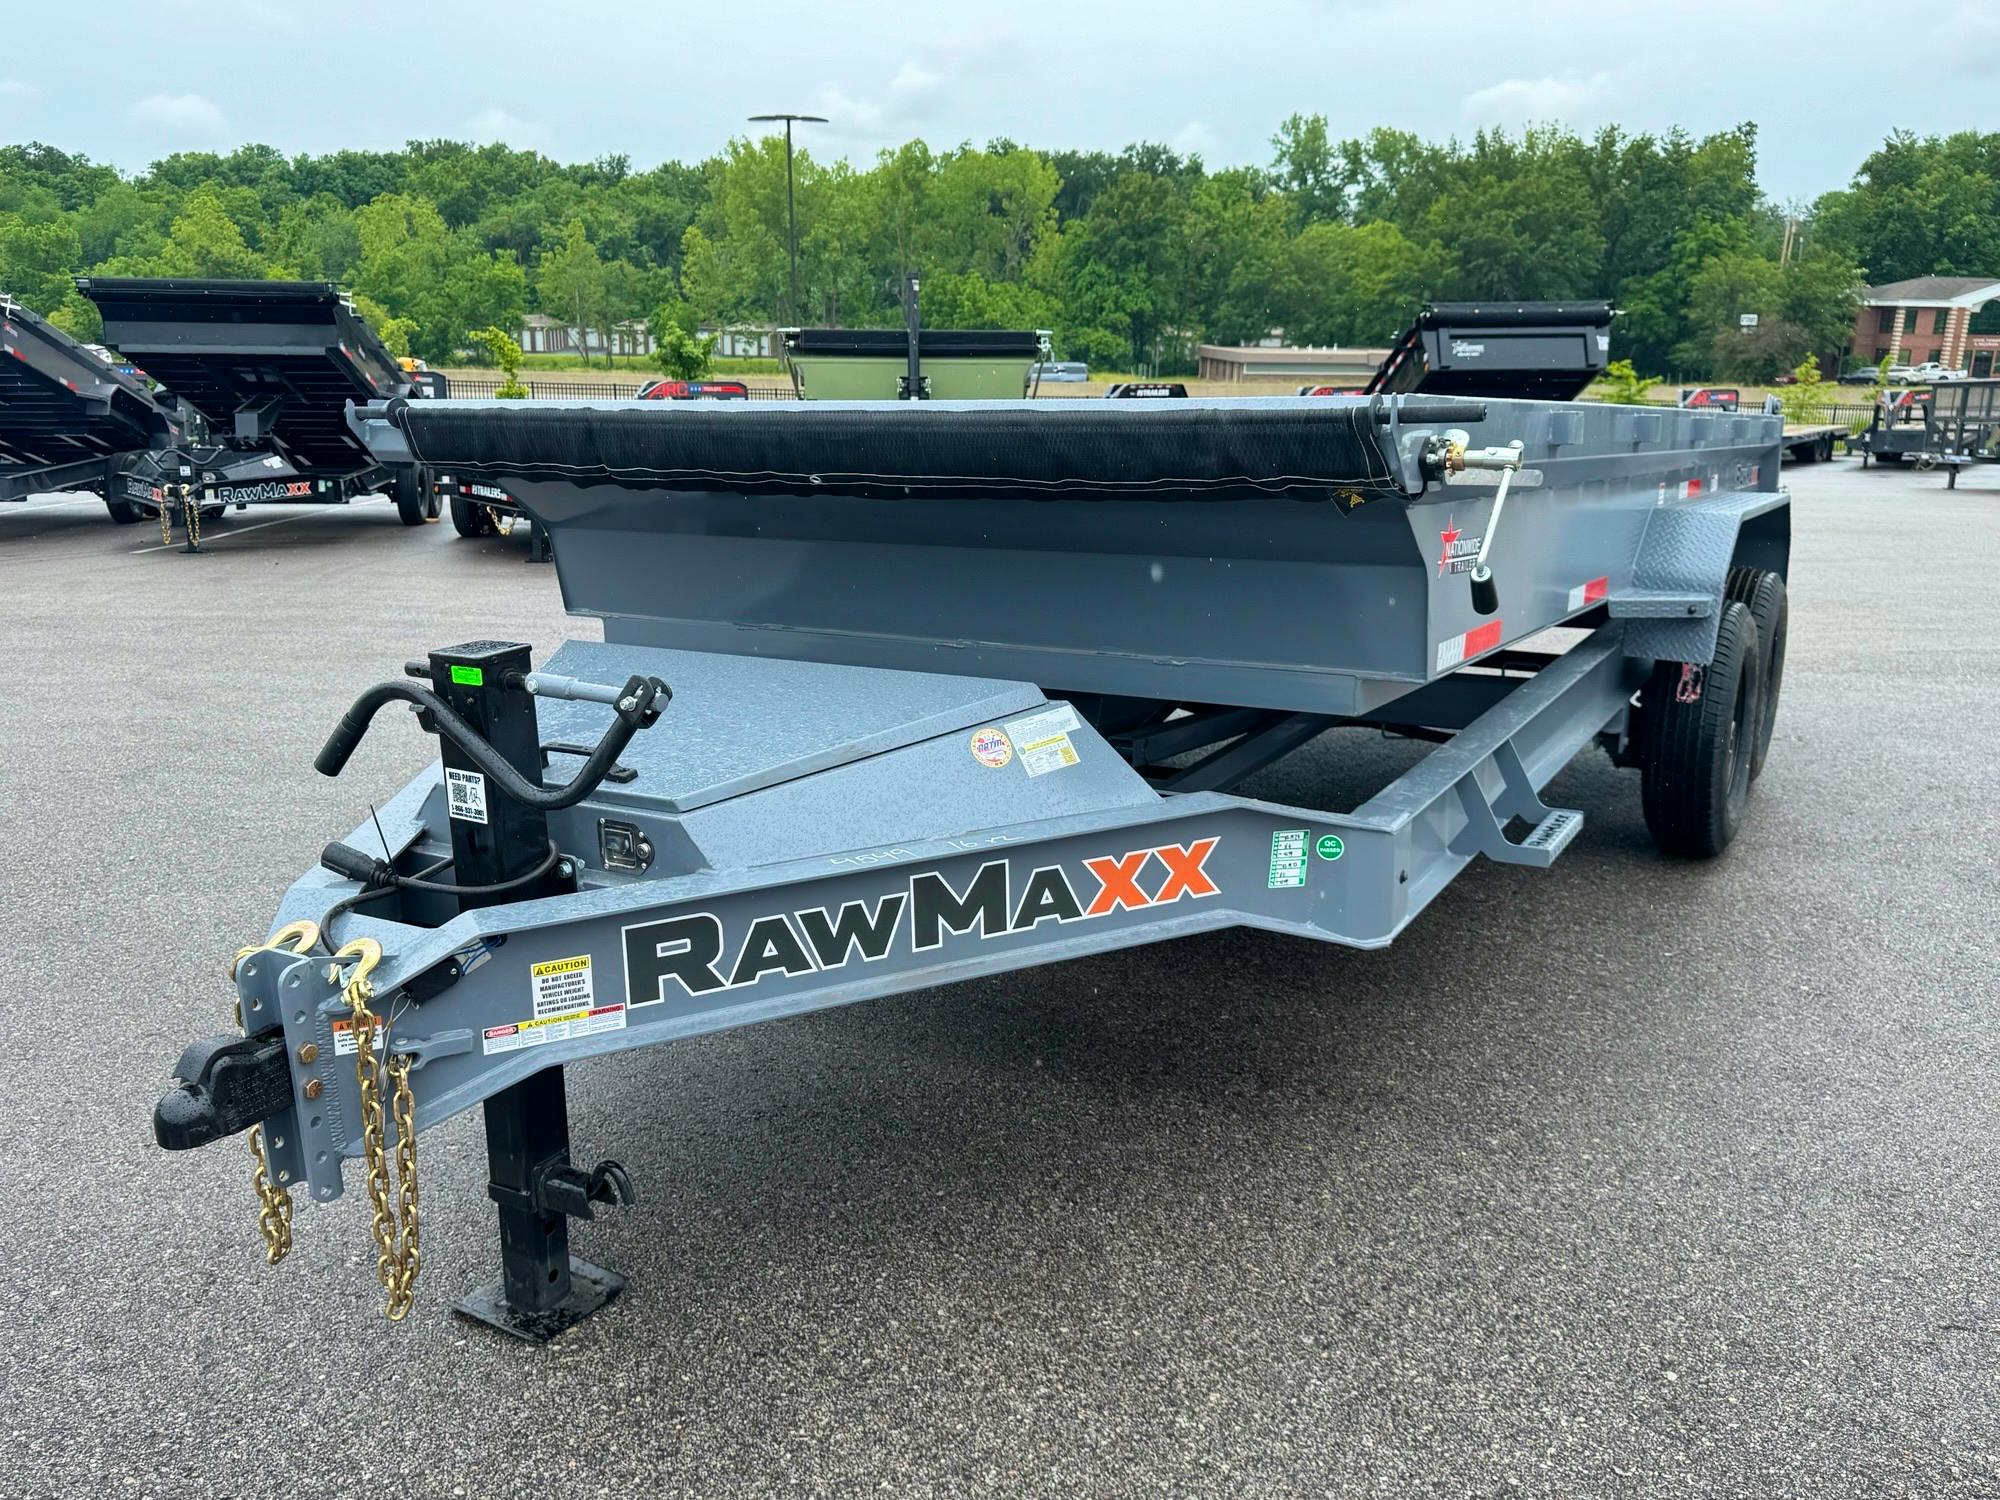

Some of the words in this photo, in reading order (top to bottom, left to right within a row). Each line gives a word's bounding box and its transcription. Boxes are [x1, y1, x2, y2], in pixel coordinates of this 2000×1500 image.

[1445, 537, 1481, 557] NATIONWIDE
[1324, 840, 1337, 848] QC
[544, 959, 587, 974] CAUTION
[563, 972, 583, 981] EXCEED
[539, 979, 586, 992] MANUFACTURER'S
[542, 991, 563, 1000] VEHICLE
[564, 986, 585, 996] WEIGHT
[537, 998, 560, 1008] RATINGS
[568, 992, 591, 1002] LOADING
[535, 1016, 562, 1026] CAUTION
